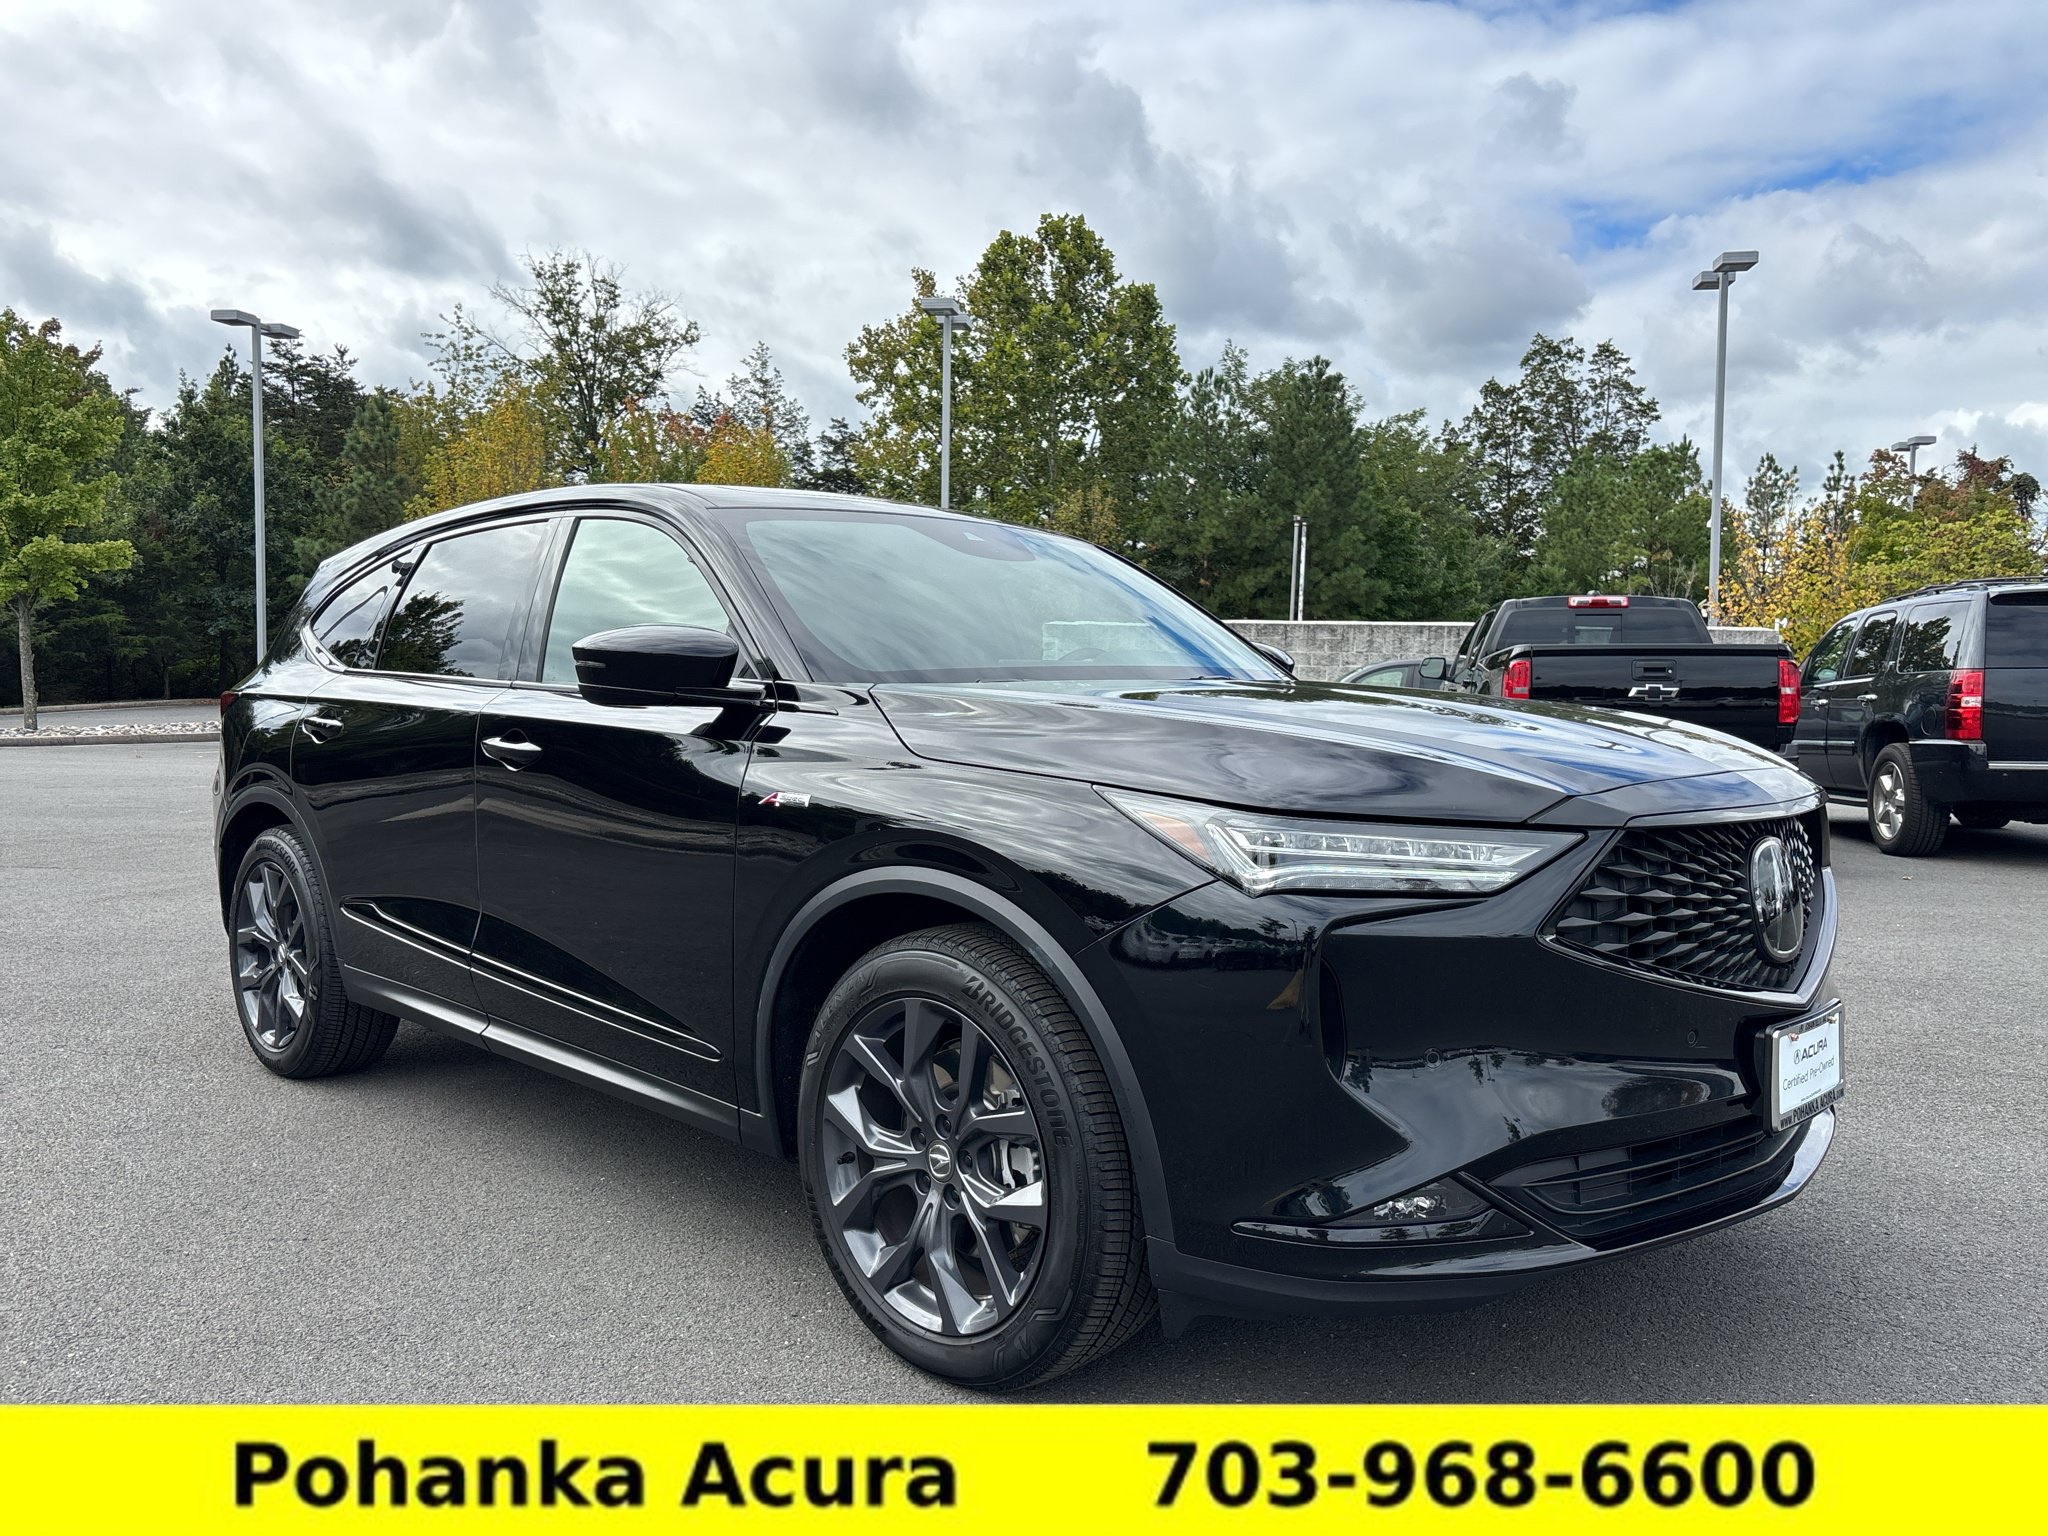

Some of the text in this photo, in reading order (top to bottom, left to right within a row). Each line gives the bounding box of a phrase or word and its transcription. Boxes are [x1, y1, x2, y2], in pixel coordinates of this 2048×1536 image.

[961, 975, 1074, 1148] BRIDGESTONE
[1801, 1037, 1828, 1062] ACURA
[1783, 1056, 1834, 1090] Certified Pre-Owned
